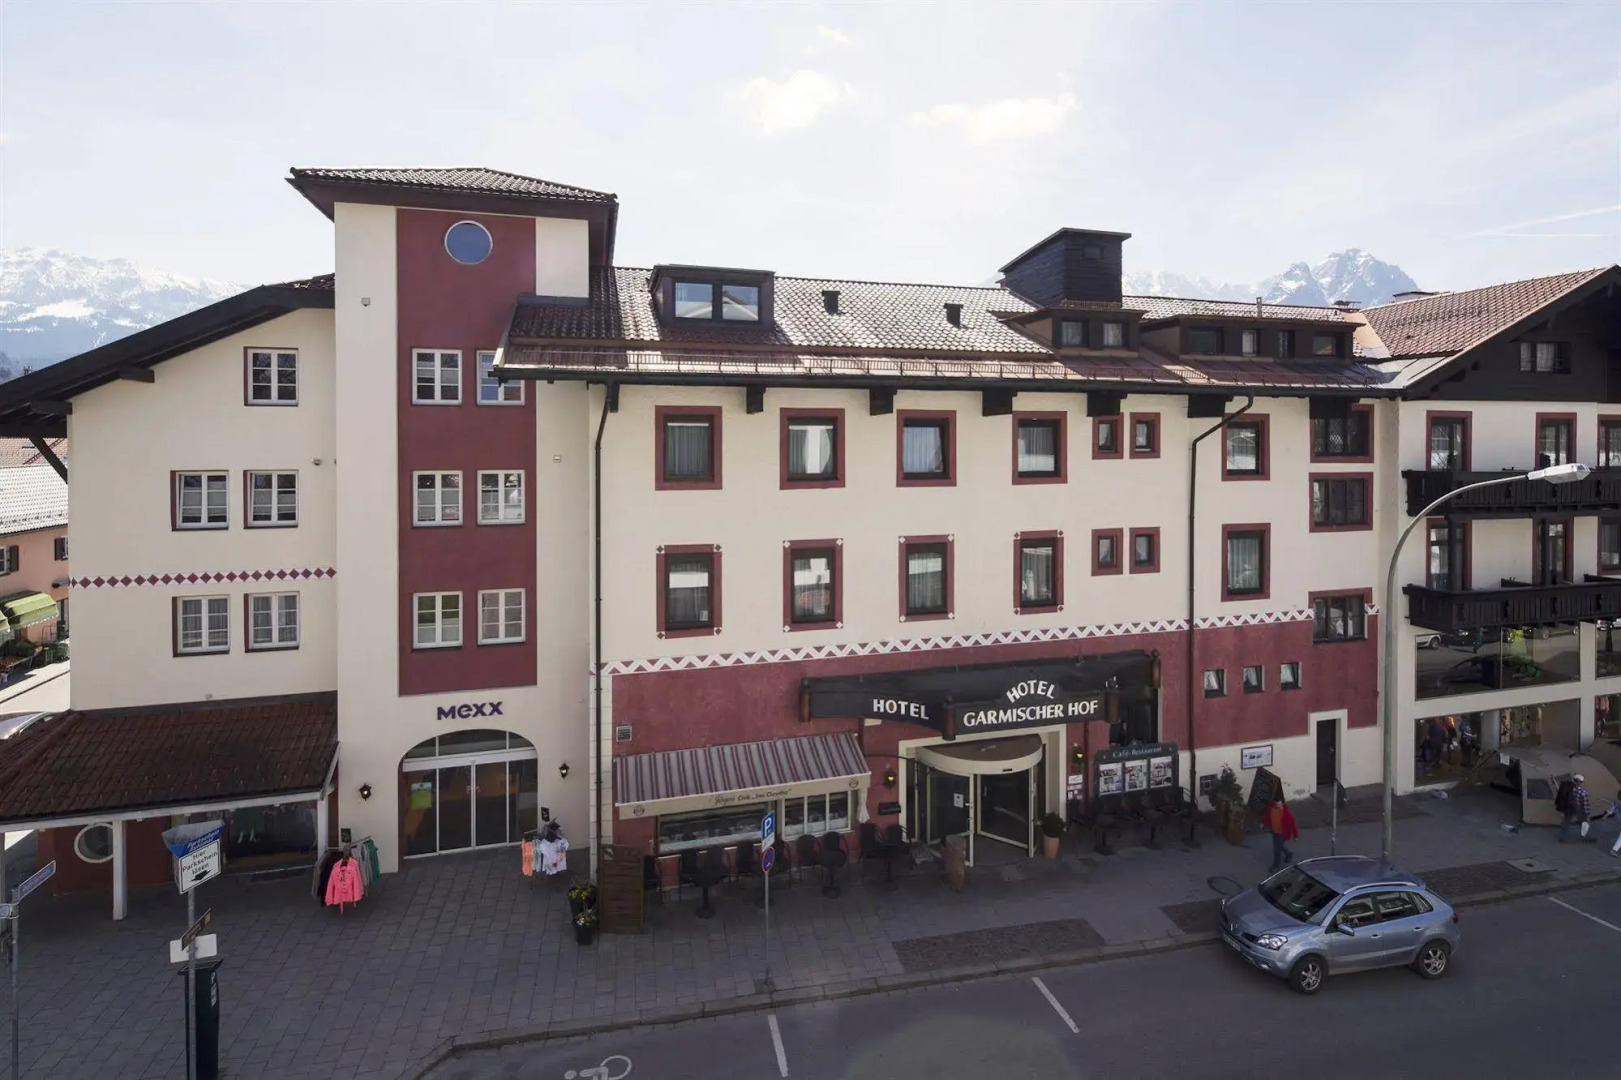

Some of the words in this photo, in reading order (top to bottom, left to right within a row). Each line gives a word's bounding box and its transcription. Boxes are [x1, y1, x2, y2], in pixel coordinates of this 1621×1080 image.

[1006, 680, 1055, 703] HOTEL
[873, 699, 929, 720] HOTEL
[963, 703, 1064, 727] GARMISCHER
[1068, 700, 1098, 717] HOF
[182, 851, 218, 873] Parkschein
[192, 850, 207, 860] Hier
